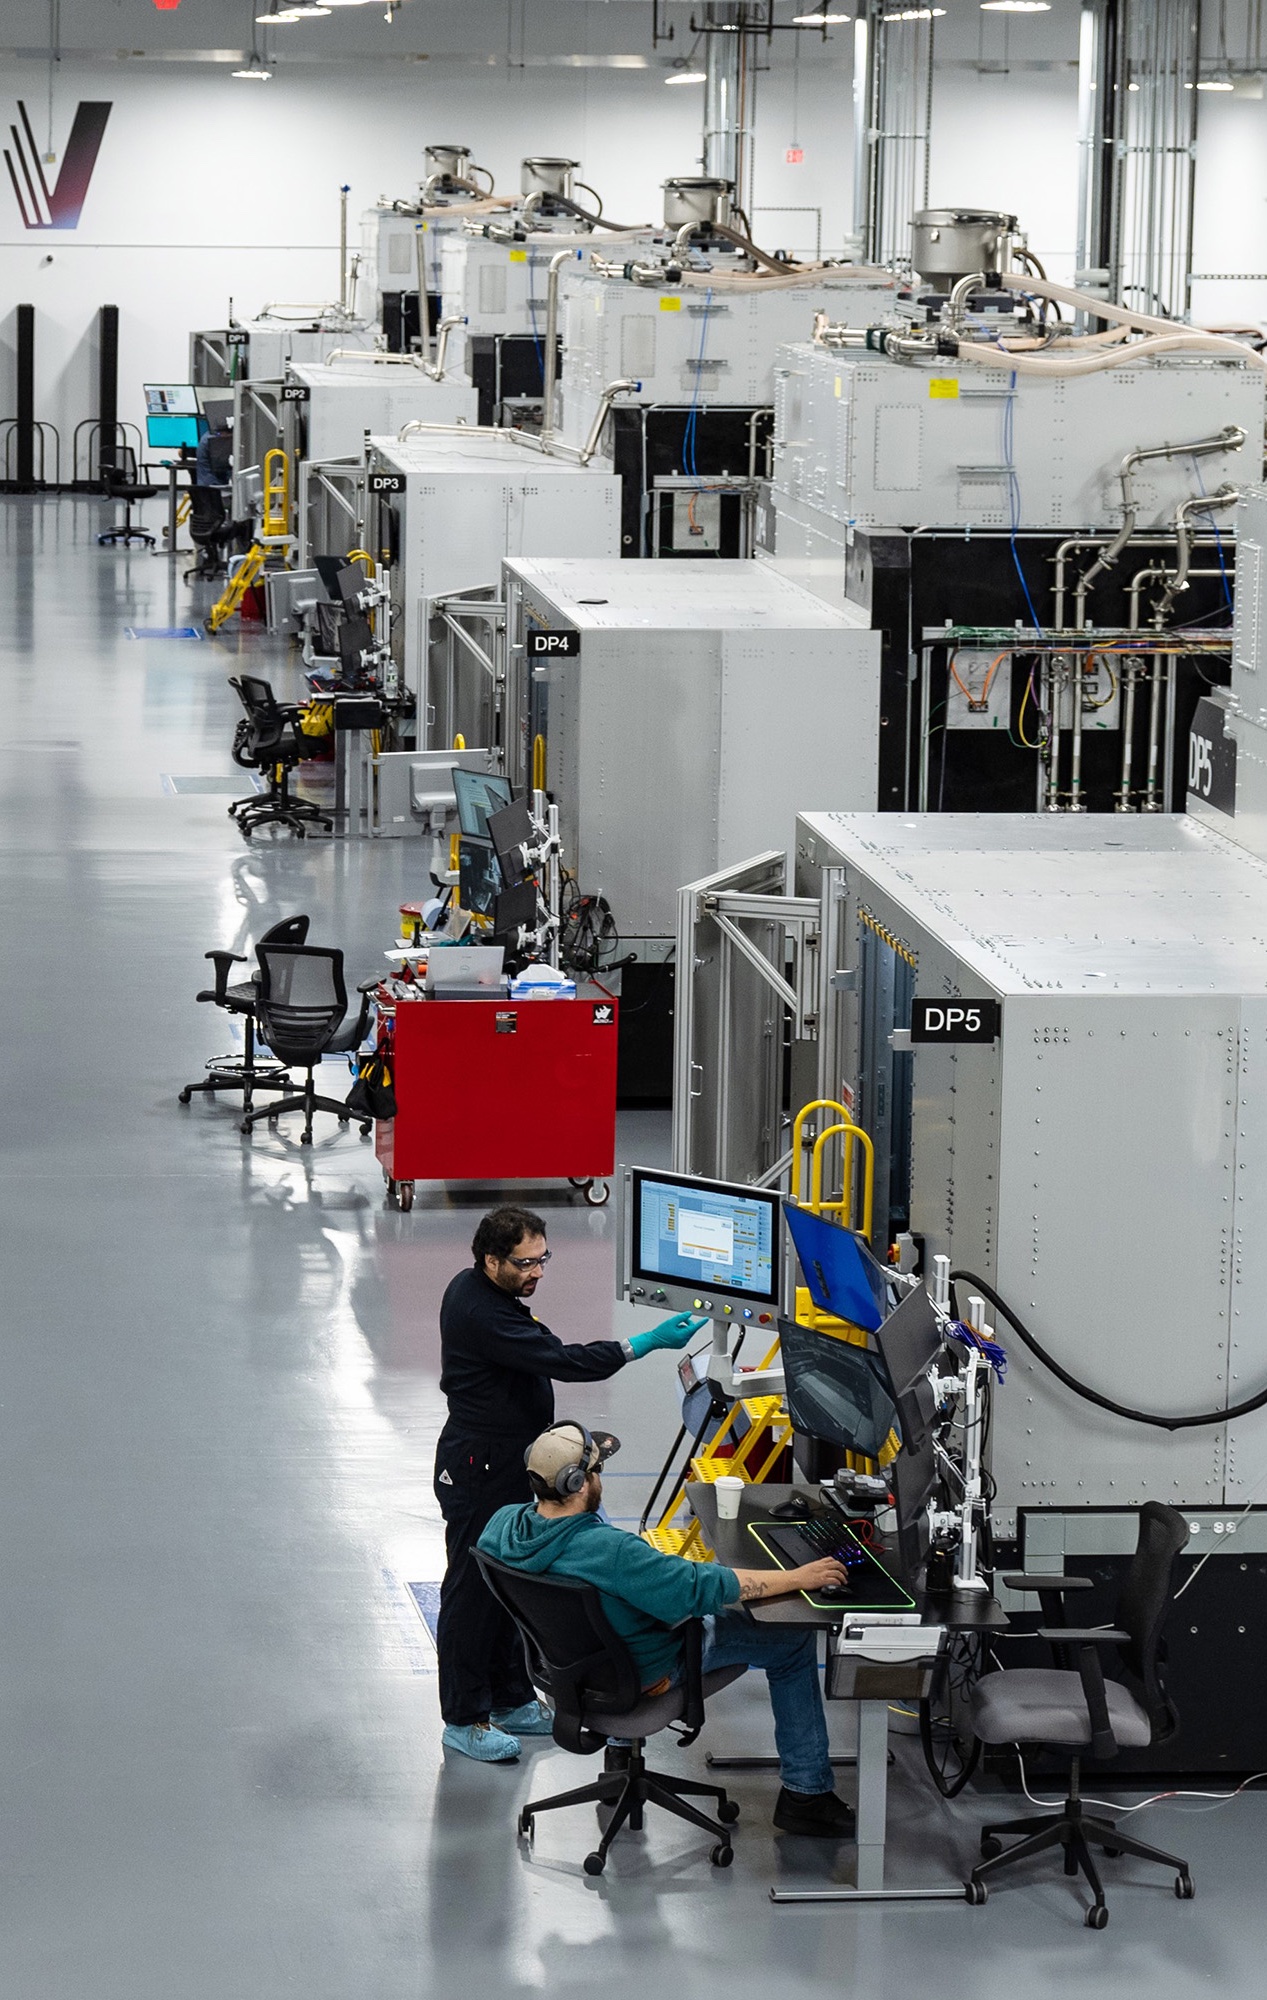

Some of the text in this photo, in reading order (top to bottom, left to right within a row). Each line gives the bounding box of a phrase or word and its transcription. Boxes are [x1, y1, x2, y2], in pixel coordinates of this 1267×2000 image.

[229, 334, 246, 342] DP1
[285, 389, 305, 399] DP2
[373, 477, 399, 489] DP3
[535, 636, 569, 651] DP4
[1188, 731, 1213, 797] DP5
[925, 1007, 981, 1032] DP5
